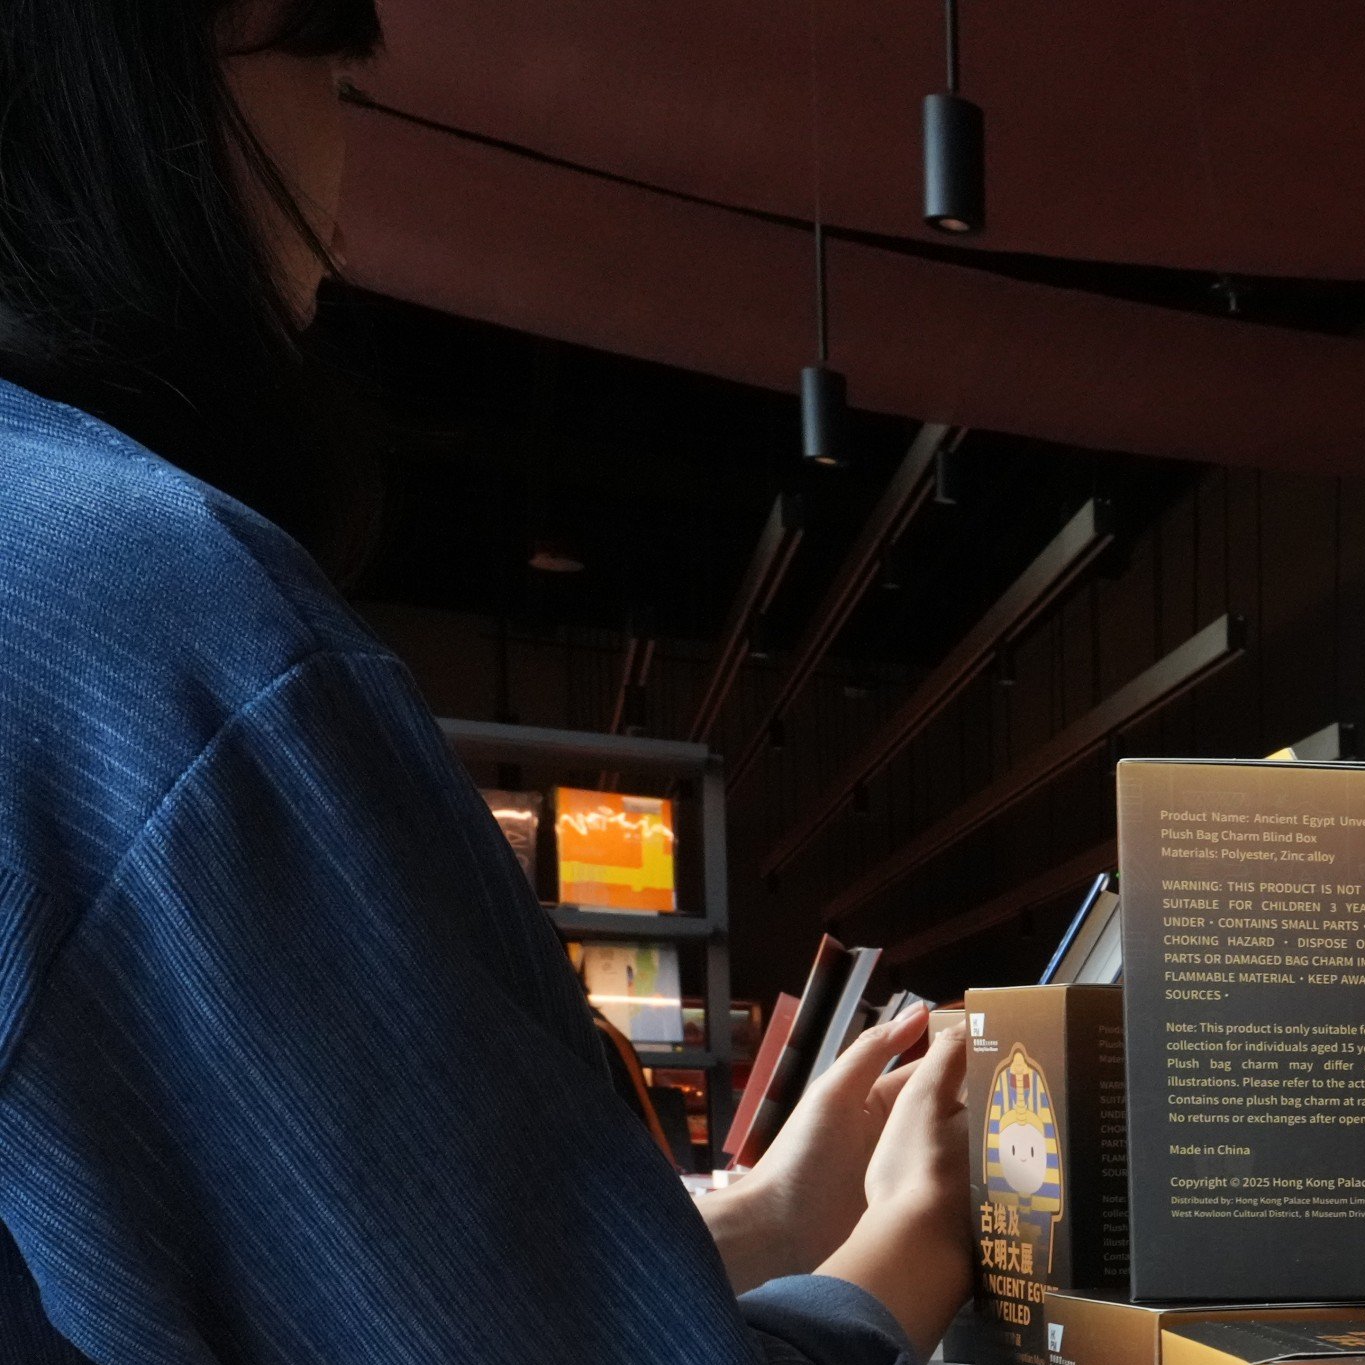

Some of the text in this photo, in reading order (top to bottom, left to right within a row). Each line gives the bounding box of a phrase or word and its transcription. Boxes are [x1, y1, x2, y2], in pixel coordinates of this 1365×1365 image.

[1160, 808, 1208, 822] Product
[1211, 811, 1249, 823] Name:
[1253, 813, 1298, 825] Ancient
[1302, 814, 1335, 828] Egypt
[1161, 828, 1317, 843] Plush Bag Charm Blind Box
[1161, 847, 1335, 864] Materials: Polyester, Zinc alloy
[1162, 880, 1223, 892] WARNING:
[1226, 881, 1255, 892] THIS
[1260, 882, 1317, 894] PRODUCT
[1321, 884, 1332, 894] IS
[1337, 884, 1362, 895] NOT
[1162, 898, 1219, 910] SUITABLE
[1228, 899, 1253, 910] FOR
[1261, 900, 1321, 912] CHILDREN
[1330, 902, 1337, 913] 3
[1163, 916, 1205, 927] UNDER
[1218, 918, 1278, 929] CONTAINS
[1281, 919, 1320, 930] SMALL
[1323, 920, 1359, 931] PARTS
[1164, 935, 1219, 946] CHOKING
[1227, 936, 1275, 947] HAZARD
[1298, 937, 1348, 949] DISPOSE
[1164, 953, 1201, 964] PARTS
[1204, 953, 1221, 964] OR
[1225, 954, 1282, 965] DAMAGED
[1285, 955, 1309, 966] BAG
[1312, 956, 1353, 967] CHARM
[1164, 971, 1236, 983] FLAMMABLE
[1239, 972, 1296, 984] MATERIAL
[1308, 974, 1338, 984] KEEP
[1170, 1144, 1251, 1155] Made in China
[1170, 1176, 1227, 1190] Copyright
[1230, 1177, 1240, 1187] ©
[1242, 1177, 1270, 1188] 2025
[1272, 1177, 1303, 1190] Hong
[1306, 1177, 1335, 1190] Kong
[980, 1201, 1020, 1237] 古埃及
[980, 1236, 1033, 1275] 文明大展
